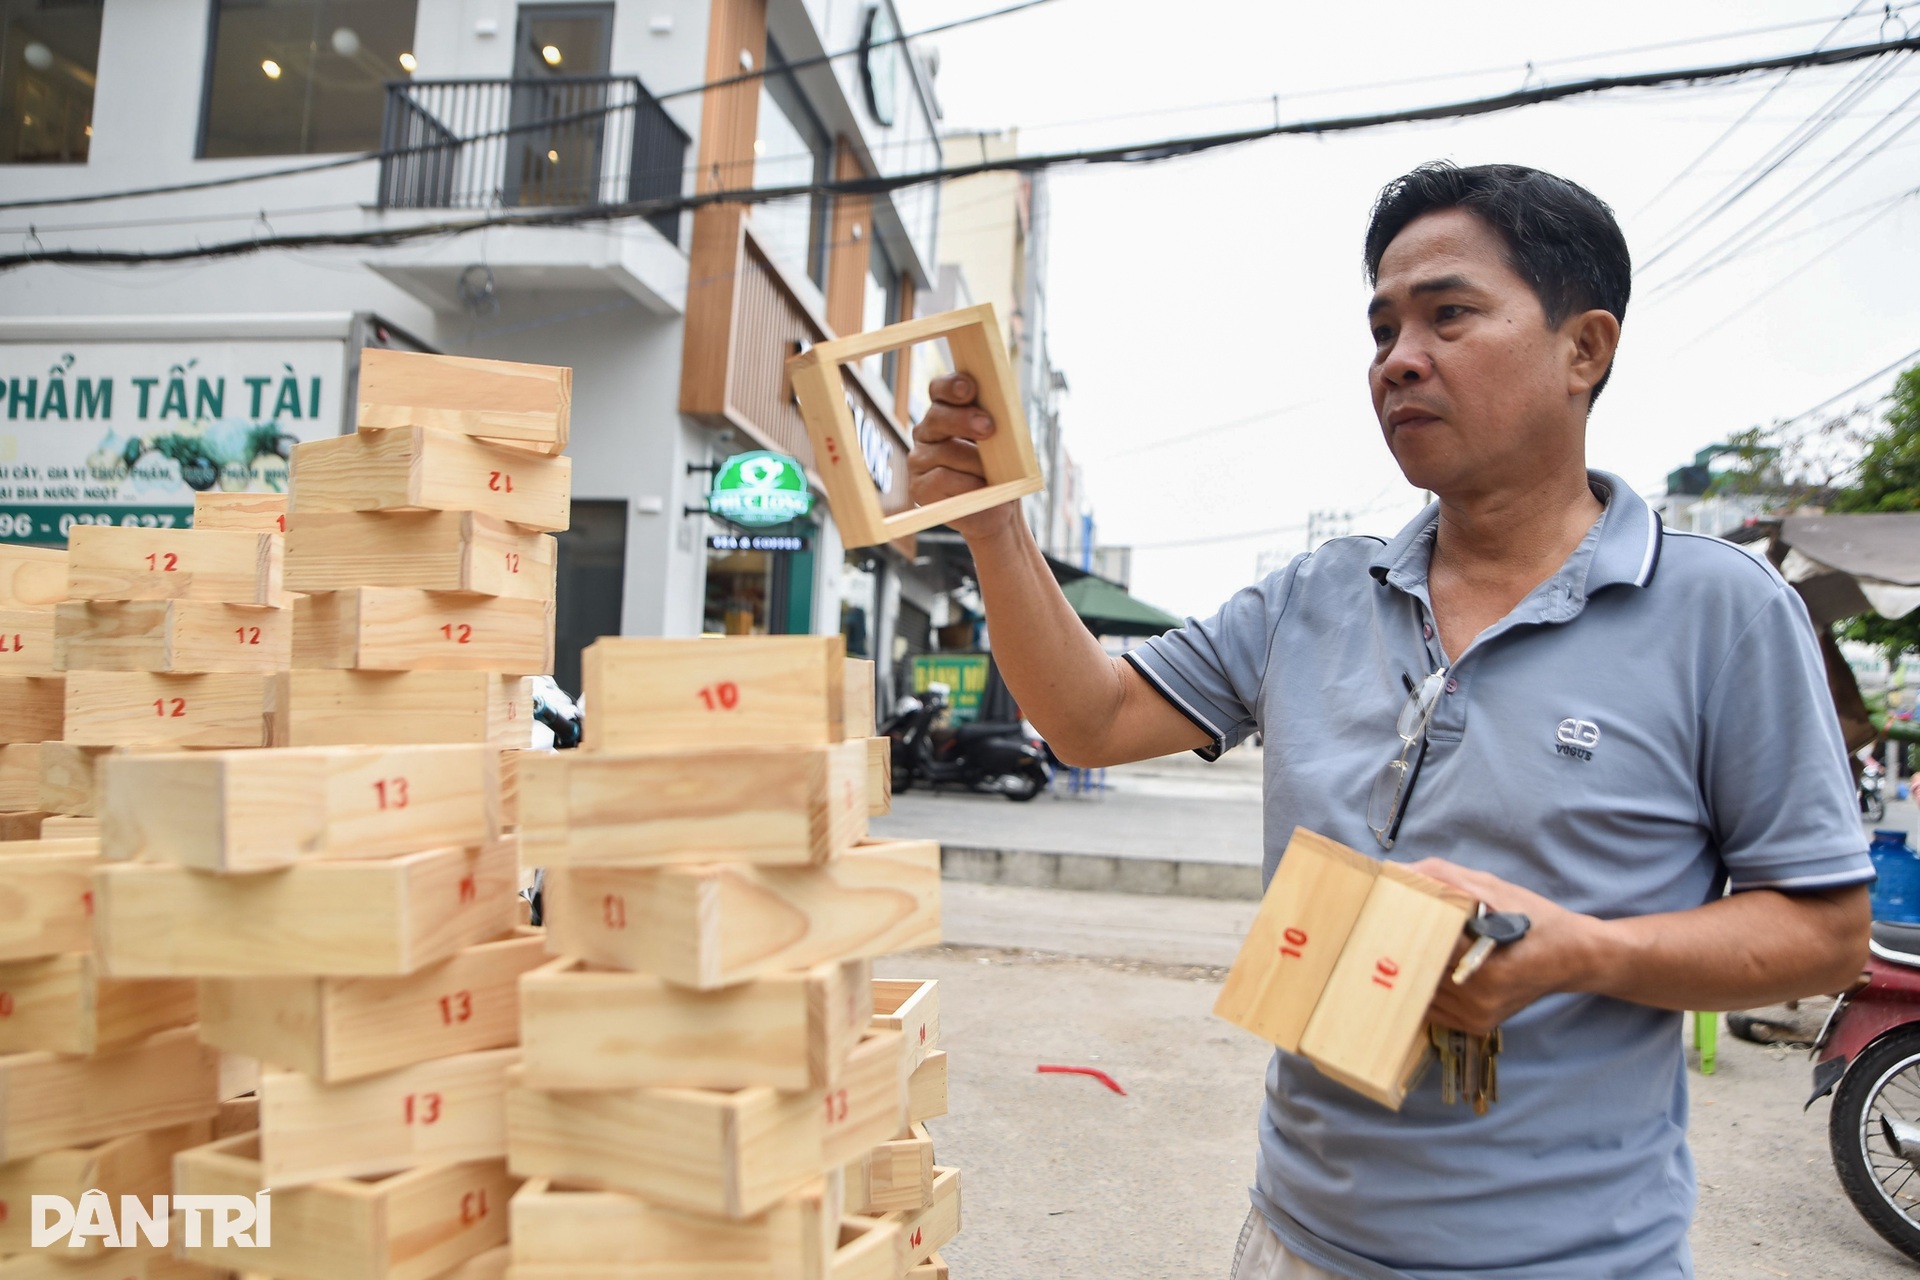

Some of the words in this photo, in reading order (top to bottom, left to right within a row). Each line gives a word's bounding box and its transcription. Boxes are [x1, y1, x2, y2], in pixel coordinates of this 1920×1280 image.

[0, 352, 113, 419] HẨM
[132, 358, 225, 420] TẤN
[244, 361, 321, 420] TÀI
[488, 471, 514, 493] 12
[145, 552, 179, 572] 12
[505, 552, 519, 573] 12
[235, 627, 261, 644] 12
[440, 623, 472, 644] 12
[153, 697, 187, 717] 12
[697, 681, 740, 711] 10
[1555, 744, 1592, 761] VOGUE
[371, 777, 409, 811] 13
[1279, 927, 1307, 958] 10
[1371, 957, 1399, 989] 10
[439, 989, 472, 1026] 13
[404, 1092, 442, 1126] 13
